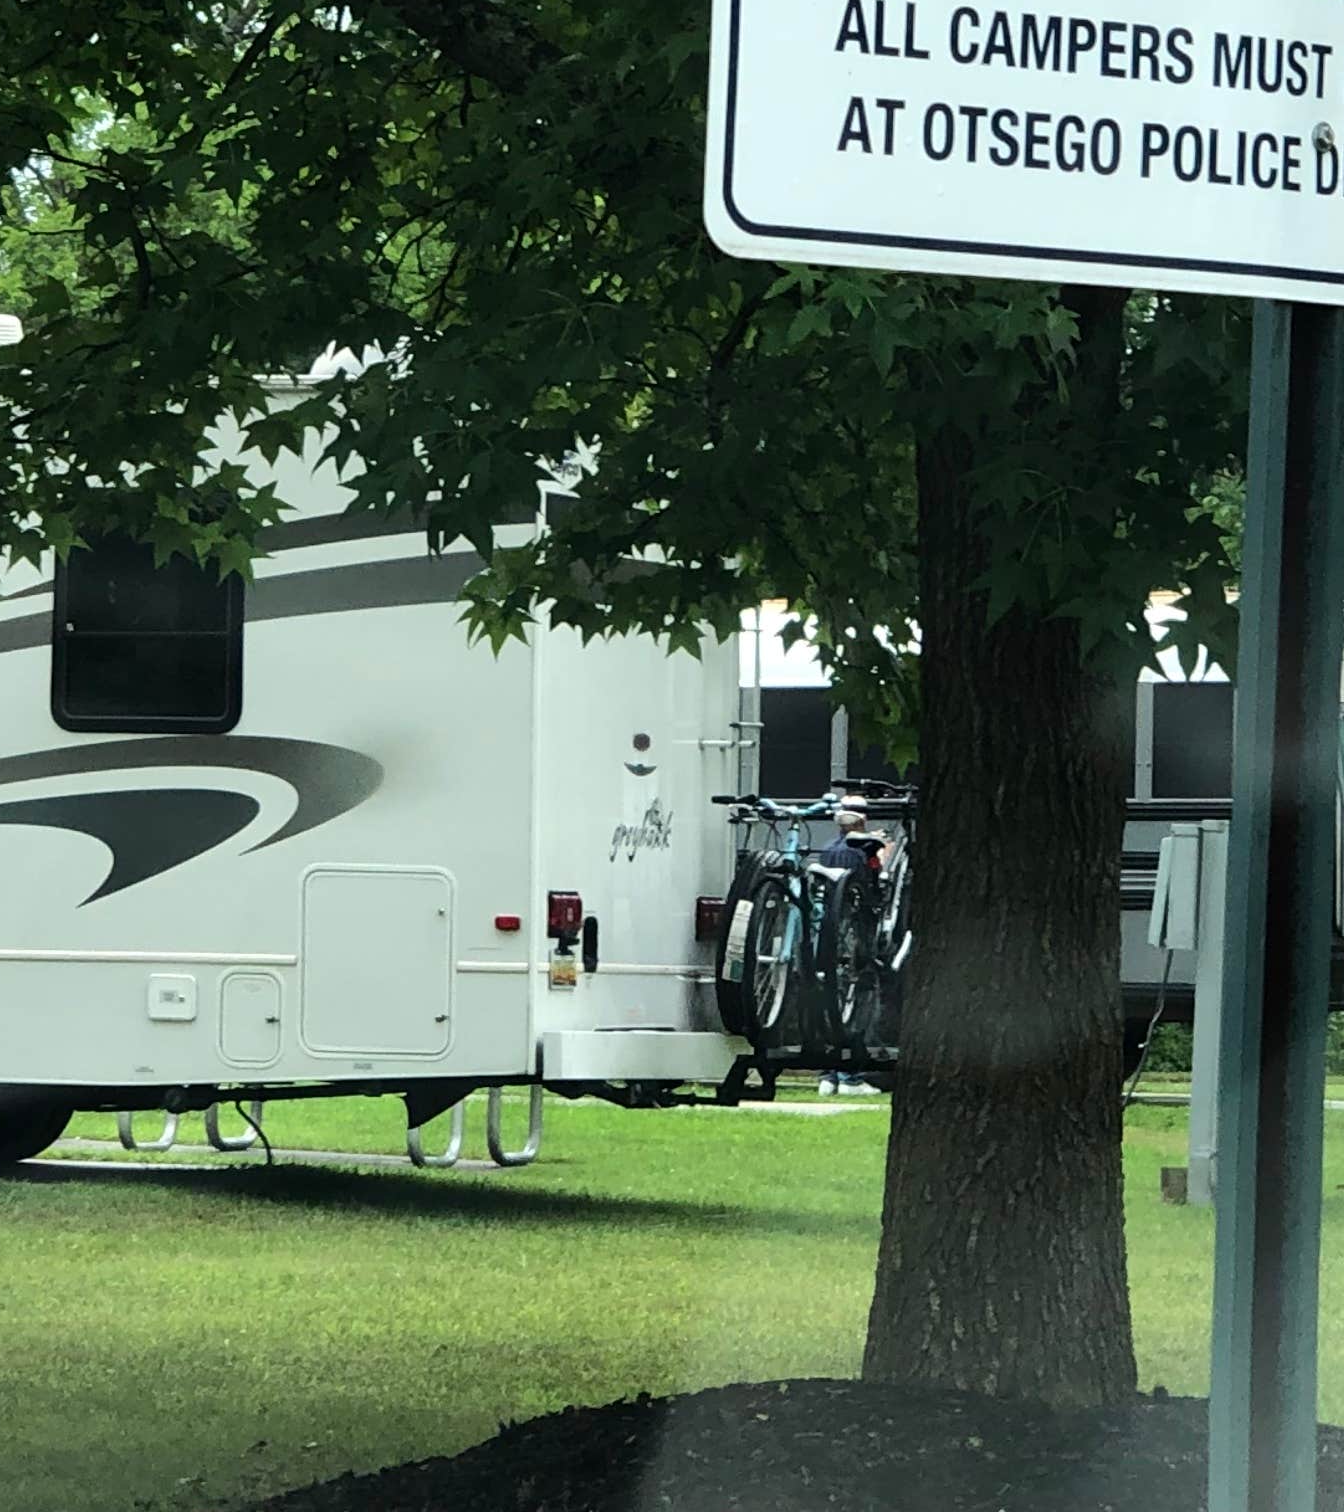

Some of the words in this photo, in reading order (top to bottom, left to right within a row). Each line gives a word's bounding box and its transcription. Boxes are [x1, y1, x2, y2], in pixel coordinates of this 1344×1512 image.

[950, 6, 1193, 84] CAMPERS
[1213, 32, 1333, 99] MUST
[837, 96, 905, 156] AT
[923, 102, 1121, 176] OTSEGO
[1141, 123, 1302, 192] POLICE
